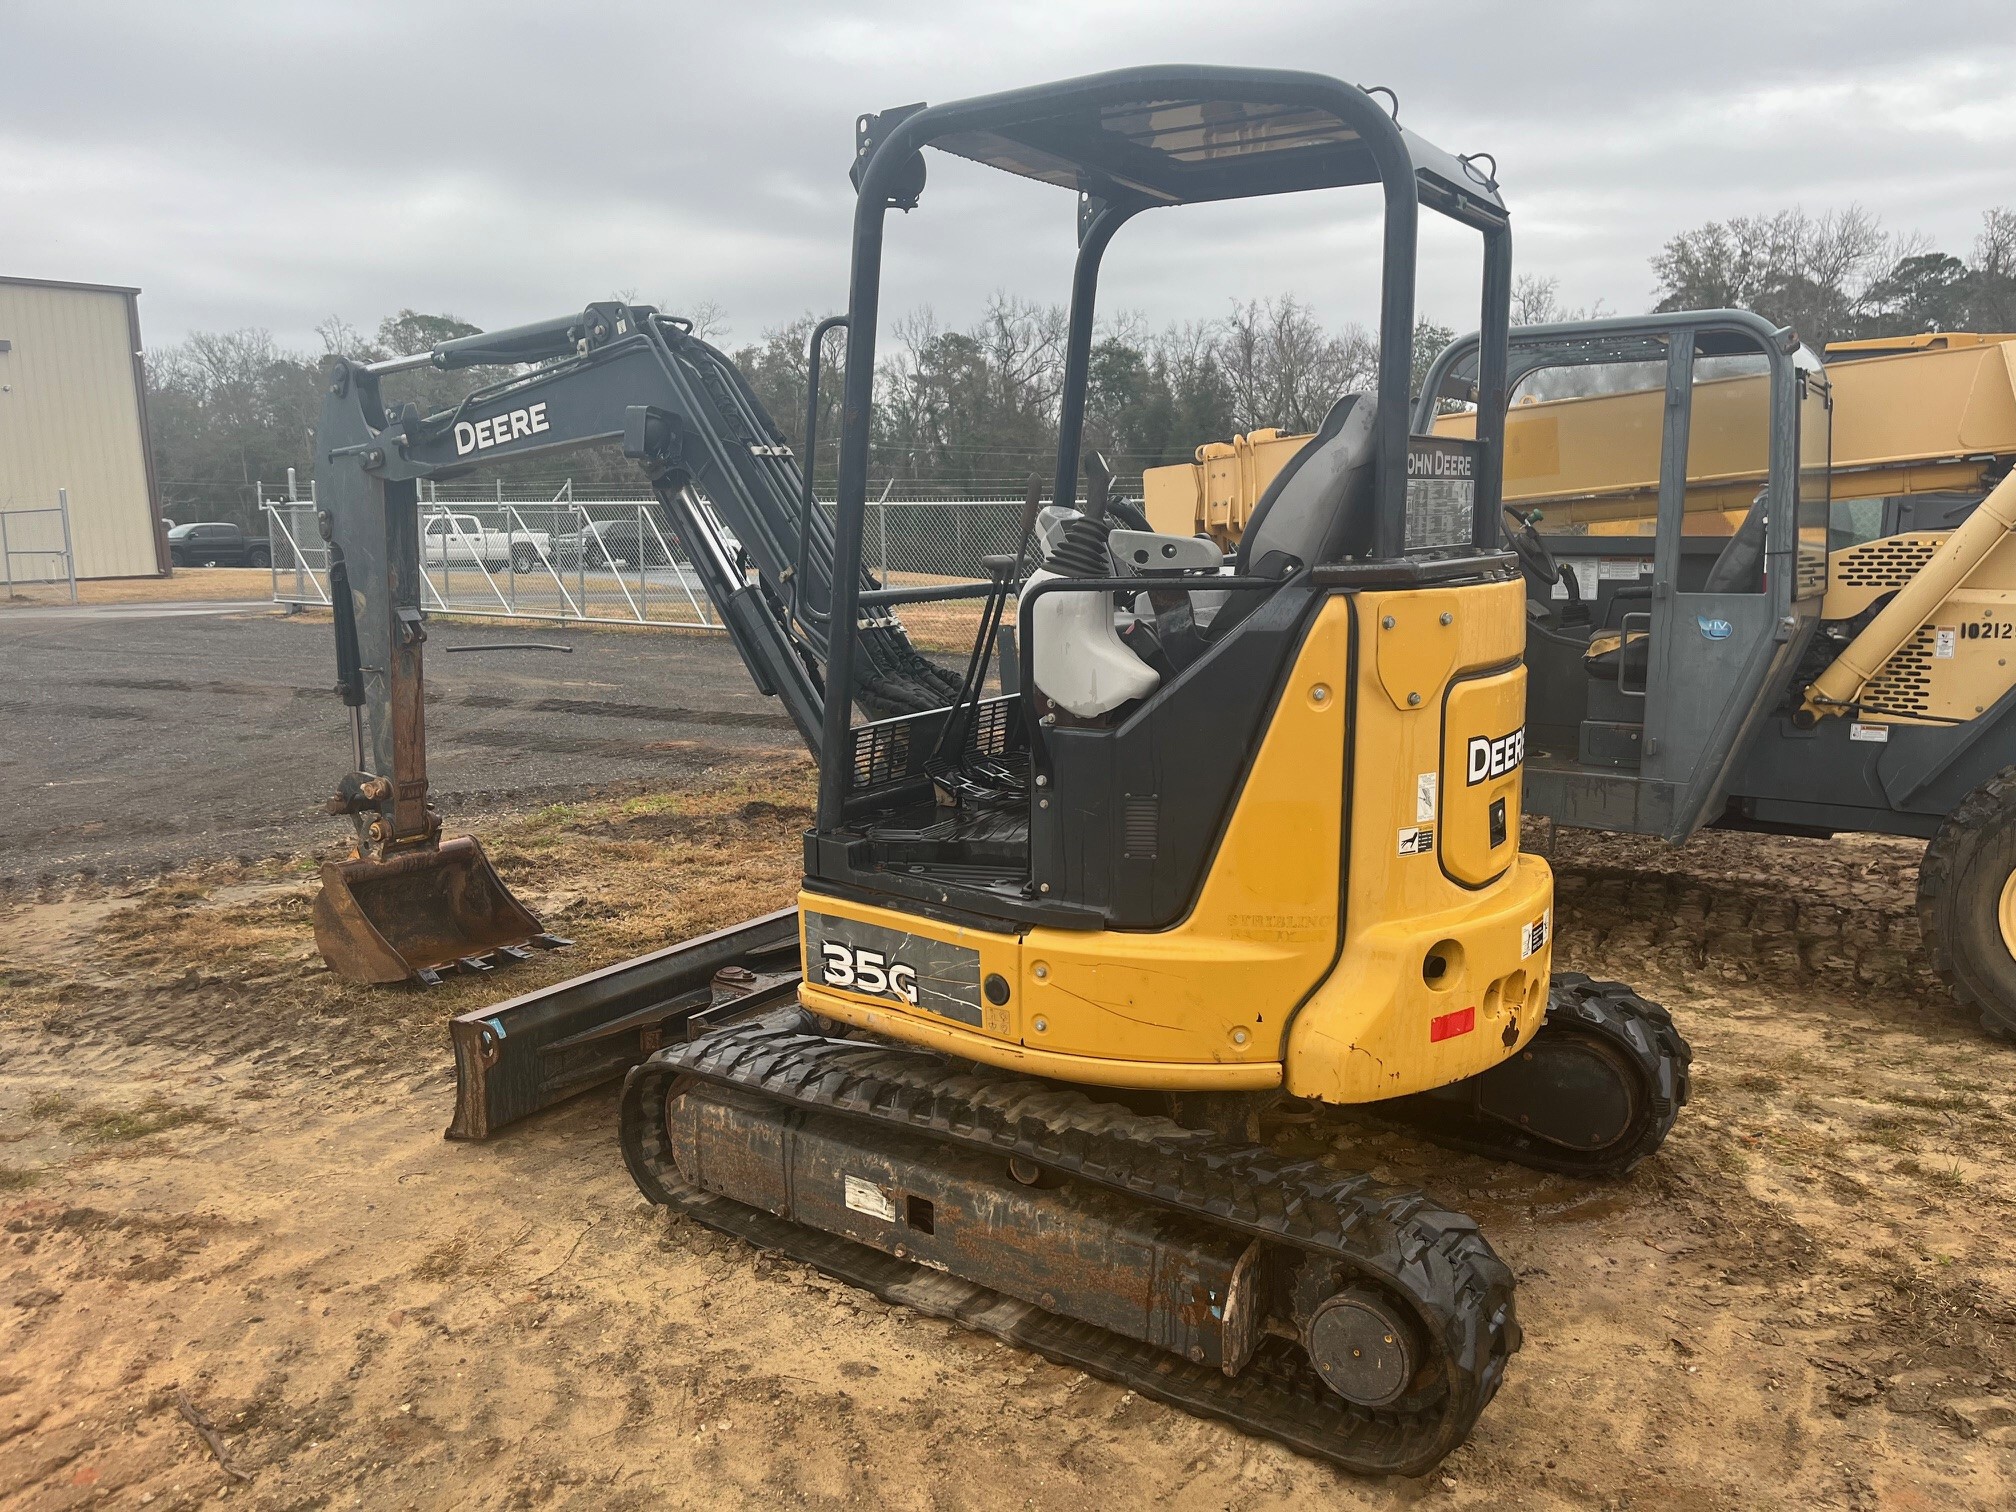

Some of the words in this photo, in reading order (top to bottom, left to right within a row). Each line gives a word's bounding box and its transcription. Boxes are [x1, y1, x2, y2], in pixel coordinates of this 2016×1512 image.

[454, 402, 550, 456] DEERE
[1407, 453, 1433, 475] OHN
[1435, 450, 1472, 476] DEERE
[1961, 622, 2016, 639] 10212
[822, 942, 919, 1004] 35G
